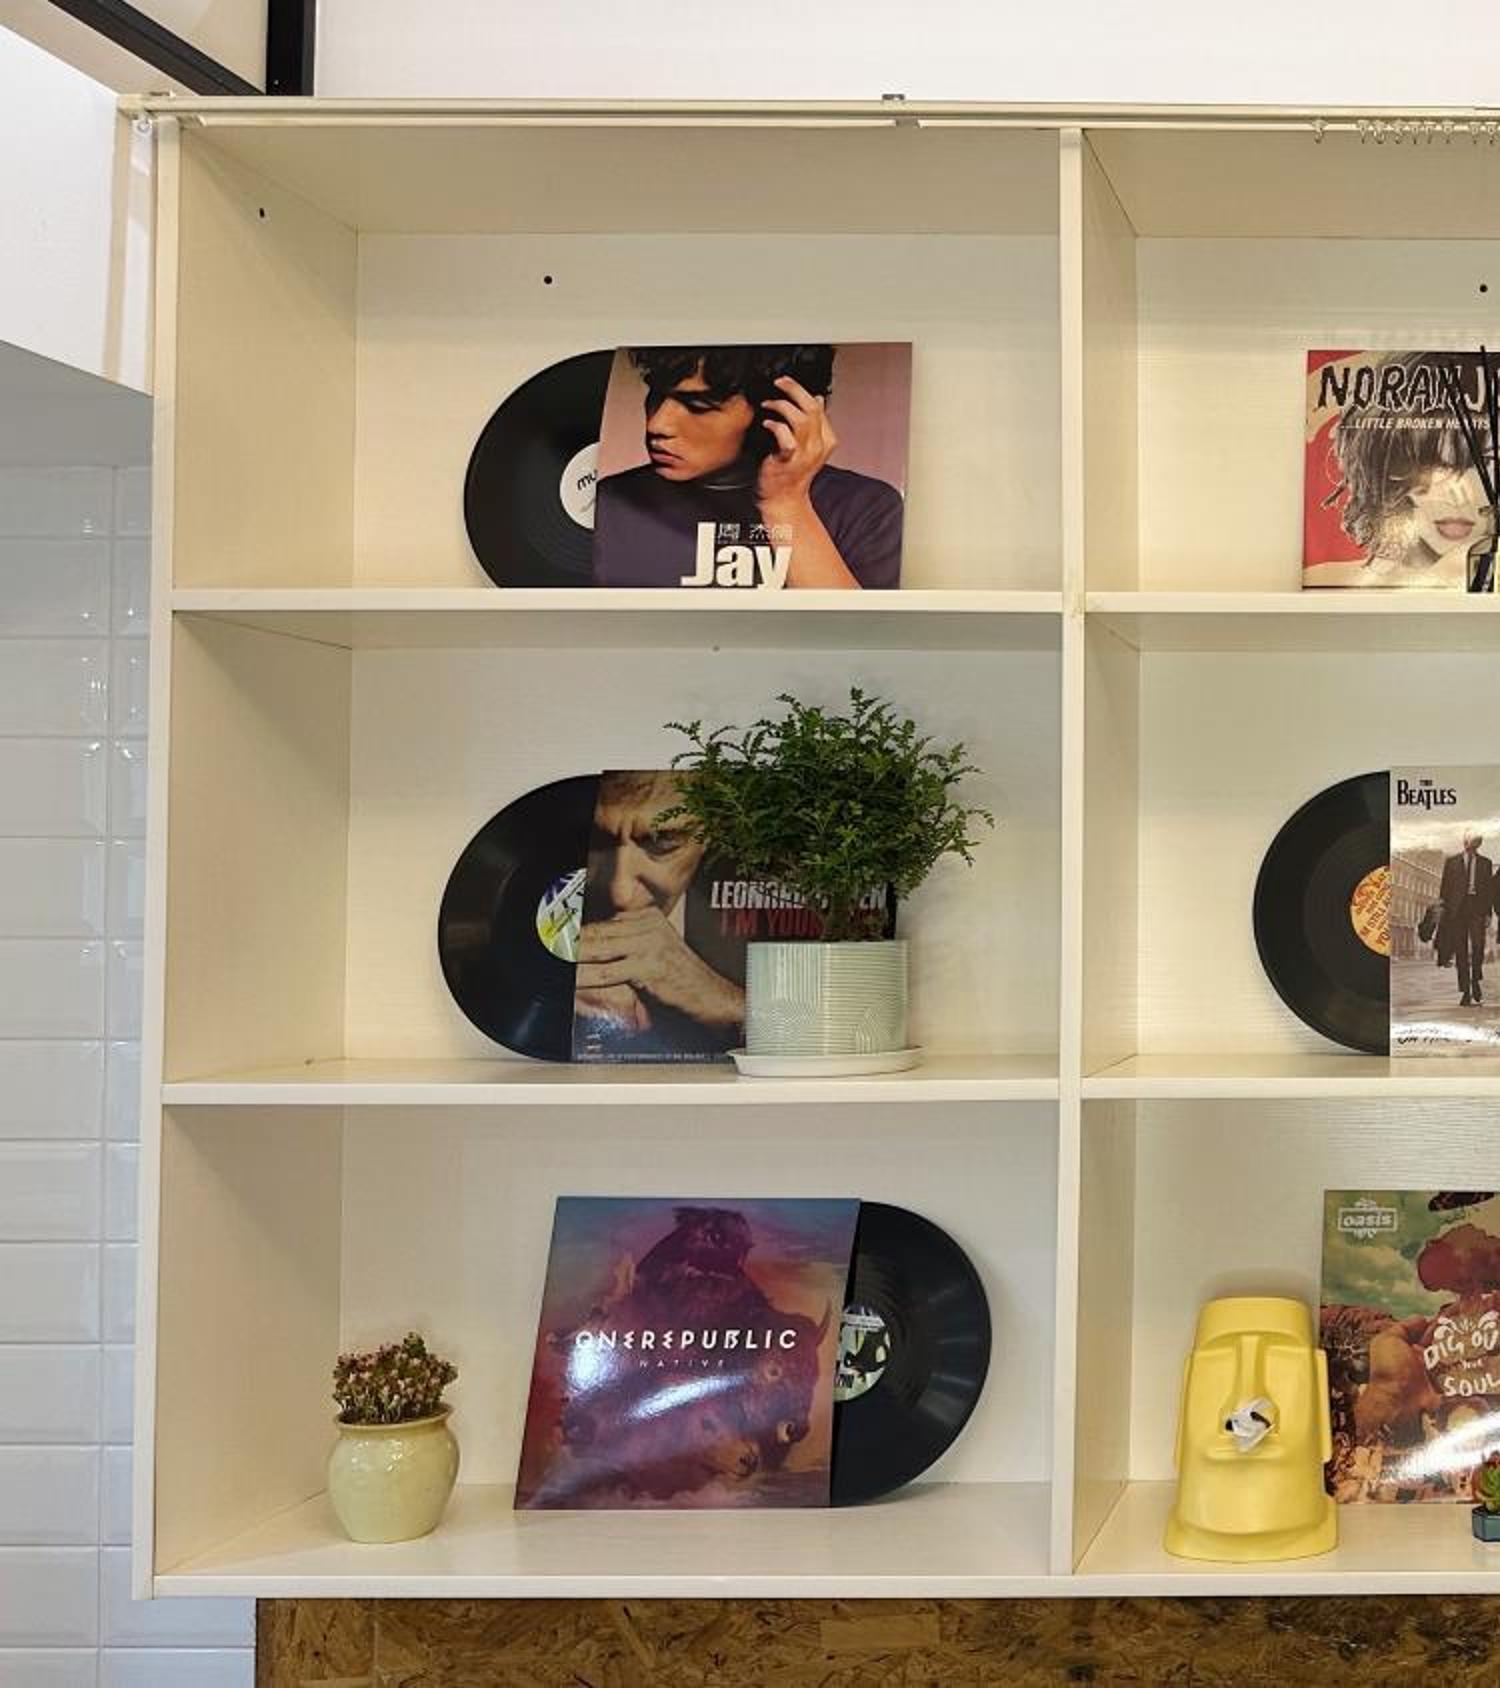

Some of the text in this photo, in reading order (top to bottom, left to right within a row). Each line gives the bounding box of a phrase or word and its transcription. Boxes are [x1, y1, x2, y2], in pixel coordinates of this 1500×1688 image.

[681, 521, 793, 591] Jay
[1343, 1211, 1393, 1228] oasis
[575, 1329, 798, 1350] ONEREPUBLIC
[638, 1358, 726, 1369] NATIVE
